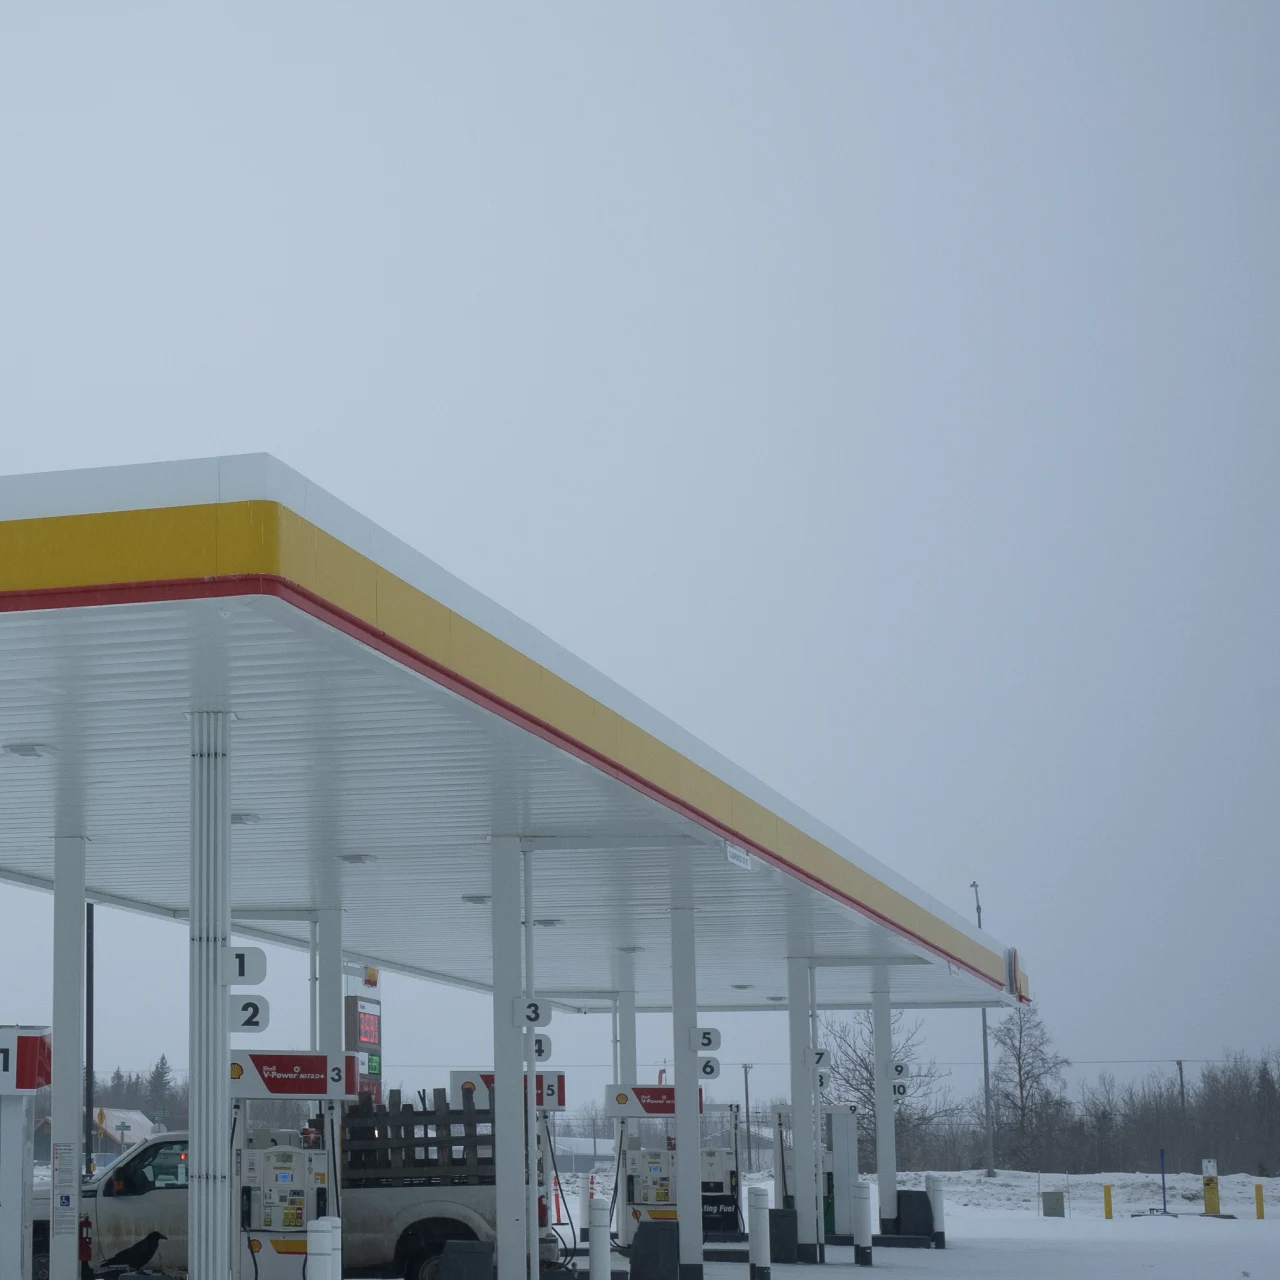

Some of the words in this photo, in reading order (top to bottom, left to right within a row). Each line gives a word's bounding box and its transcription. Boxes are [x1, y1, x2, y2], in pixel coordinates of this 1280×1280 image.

[235, 953, 245, 977] 1
[241, 1002, 260, 1026] 2
[525, 1003, 540, 1022] 3
[701, 1032, 712, 1047] 5
[535, 1039, 544, 1057] 4
[0, 1048, 9, 1072] 1
[815, 1052, 825, 1064] 7
[263, 1071, 297, 1079] V-Power
[330, 1067, 342, 1082] 3
[702, 1060, 715, 1075] 6
[895, 1065, 904, 1075] 9
[546, 1084, 556, 1096] 5
[892, 1084, 906, 1095] 10
[850, 1105, 857, 1114] 9
[703, 1204, 718, 1214] ting
[719, 1204, 735, 1212] Fuel
